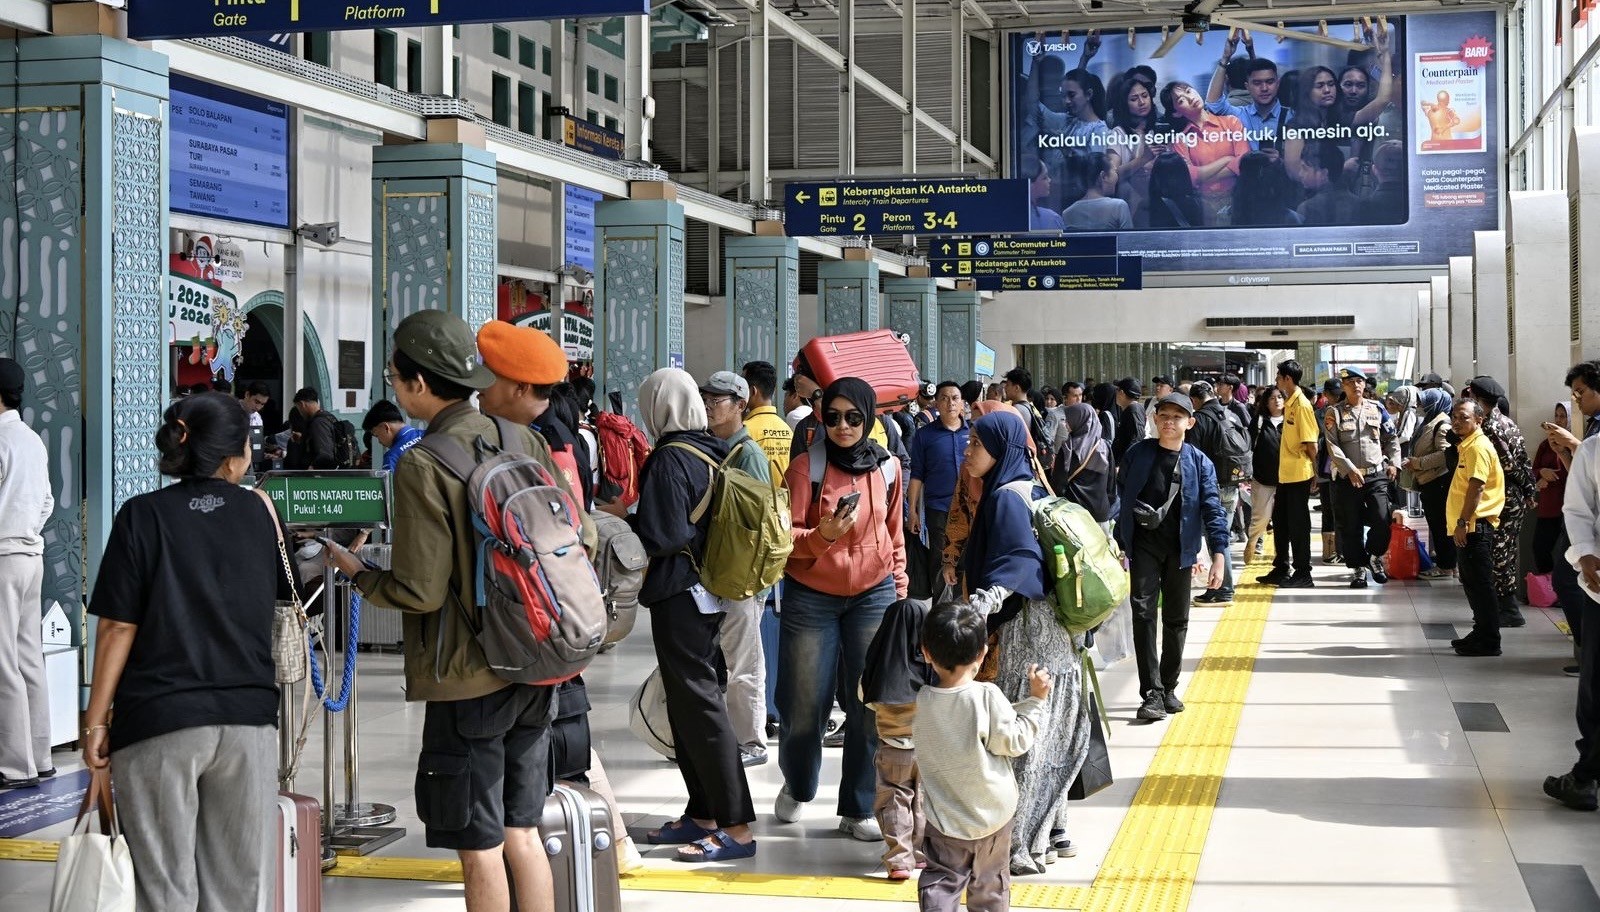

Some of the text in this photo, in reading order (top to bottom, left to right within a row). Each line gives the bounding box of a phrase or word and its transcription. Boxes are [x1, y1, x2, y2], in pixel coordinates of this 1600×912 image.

[344, 5, 405, 20] Platform
[213, 13, 247, 27] Gate
[1043, 43, 1077, 51] TAISHO
[1464, 46, 1488, 58] BARU
[1421, 66, 1478, 79] Counterpain
[188, 106, 206, 118] SOLO
[206, 110, 233, 124] BALAPAN
[576, 123, 602, 144] Informasi
[602, 133, 619, 151] Kereta
[1038, 122, 1390, 151] Kalau hidup sering tertekuk, lemesin aja.
[188, 139, 238, 157] SURABAYA PASAR
[189, 151, 203, 161] TURI
[1442, 168, 1487, 177] pegal-pegal,
[189, 178, 222, 191] SEMARANG
[842, 184, 987, 197] Keberangkatan KA Antarkota
[189, 191, 216, 202] TAWANG
[842, 196, 929, 206] Intercity Train Departures
[820, 214, 846, 224] Pintu
[853, 213, 866, 231] 2
[882, 212, 911, 222] Peron
[820, 223, 915, 233] Gate Platforms
[993, 241, 1008, 249] KRL
[1009, 240, 1048, 248] Commuter
[1050, 240, 1066, 248] Line
[975, 260, 1017, 269] Kedatangan
[1030, 259, 1066, 267] Antarkota
[1002, 276, 1021, 284] Peron
[1027, 276, 1037, 288] 6
[1240, 276, 1270, 284] cityvision
[177, 284, 210, 309] 2025
[180, 307, 211, 326] 2026
[763, 429, 790, 437] PORTER
[293, 490, 319, 501] MOTIS
[320, 490, 353, 501] NATARU
[293, 504, 316, 515] Pukul
[322, 504, 343, 515] 14.40
